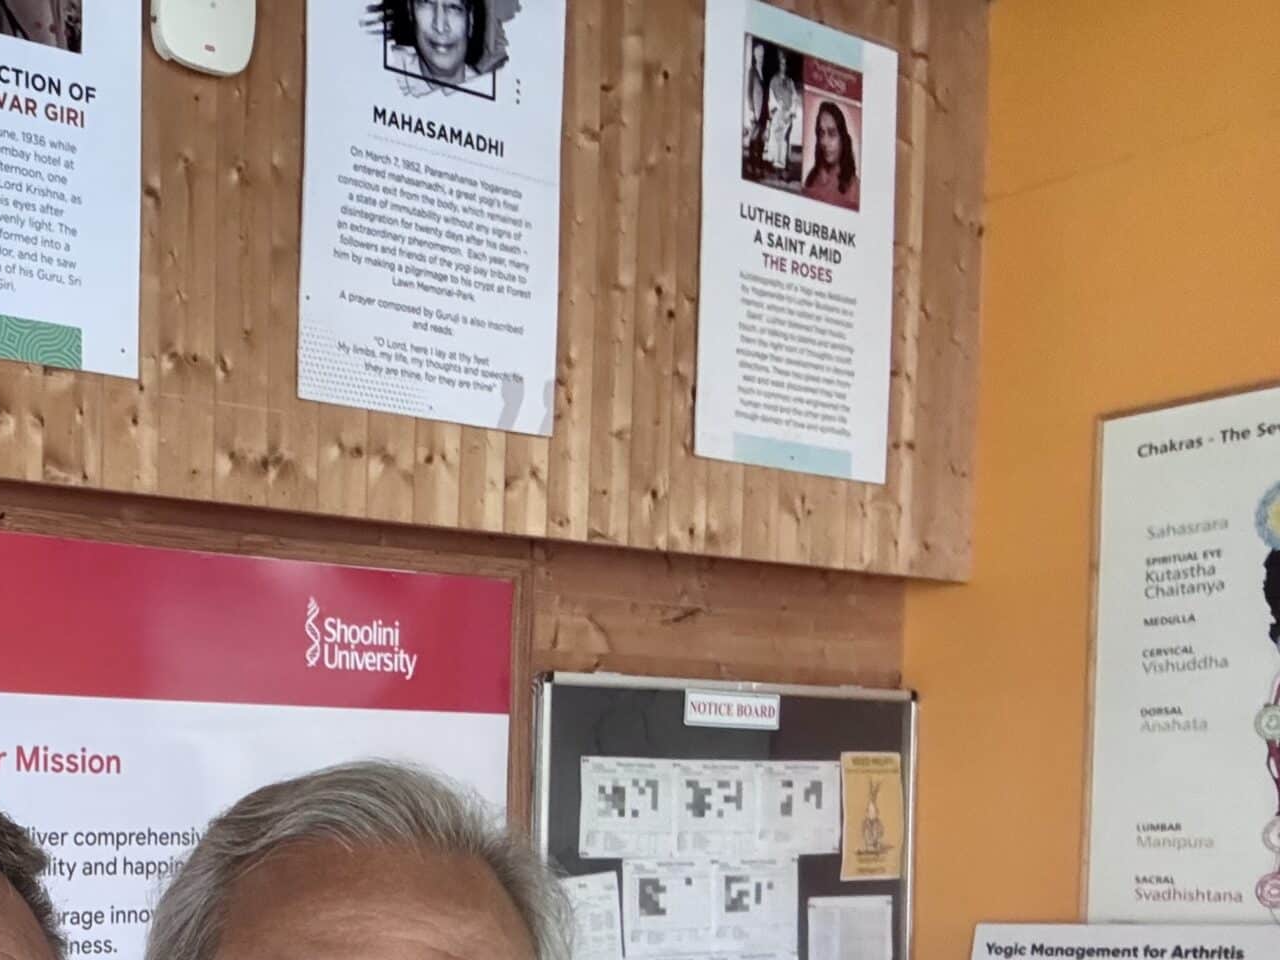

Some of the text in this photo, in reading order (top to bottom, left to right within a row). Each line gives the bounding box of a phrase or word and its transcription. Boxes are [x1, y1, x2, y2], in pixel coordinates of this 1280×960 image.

[68, 82, 96, 103] OF
[44, 103, 84, 128] GIRI
[373, 105, 503, 157] MAHASAMADHI
[48, 139, 76, 154] while
[46, 172, 67, 185] one
[12, 199, 36, 212] eyes
[38, 203, 64, 216] after
[57, 222, 77, 237] The
[740, 202, 856, 247] LUTHER BURBANK
[40, 235, 61, 250] into
[63, 242, 70, 252] a
[753, 229, 841, 264] A SAINT AMID
[17, 250, 38, 262] and
[40, 252, 54, 265] he
[56, 257, 76, 269] saw
[761, 252, 832, 283] THE ROSES
[1138, 436, 1204, 458] Chakras
[1220, 427, 1250, 444] The
[1147, 518, 1229, 540] Sahasrara
[1146, 550, 1222, 566] SPIRITUAL EYE
[1145, 564, 1216, 584] Kutastha
[1144, 578, 1225, 600] Chaitanya
[1144, 612, 1196, 627] MEDULLA
[324, 617, 399, 646] Shoolini
[1142, 645, 1194, 658] CERVICAL
[324, 644, 417, 680] University
[1142, 656, 1230, 676] Vishuddha
[690, 700, 776, 719] NOTICE BOARD
[1140, 706, 1183, 718] DORSAL
[1139, 717, 1208, 734] Anahata
[16, 746, 122, 774] Mission
[1136, 822, 1182, 832] LUMBAR
[26, 826, 207, 850] liver comprehensiv
[1136, 834, 1214, 851] Manipura
[82, 856, 118, 876] and
[1134, 888, 1243, 904] Svadhishtana
[986, 942, 1244, 960] Yogic Management for Arthritis
